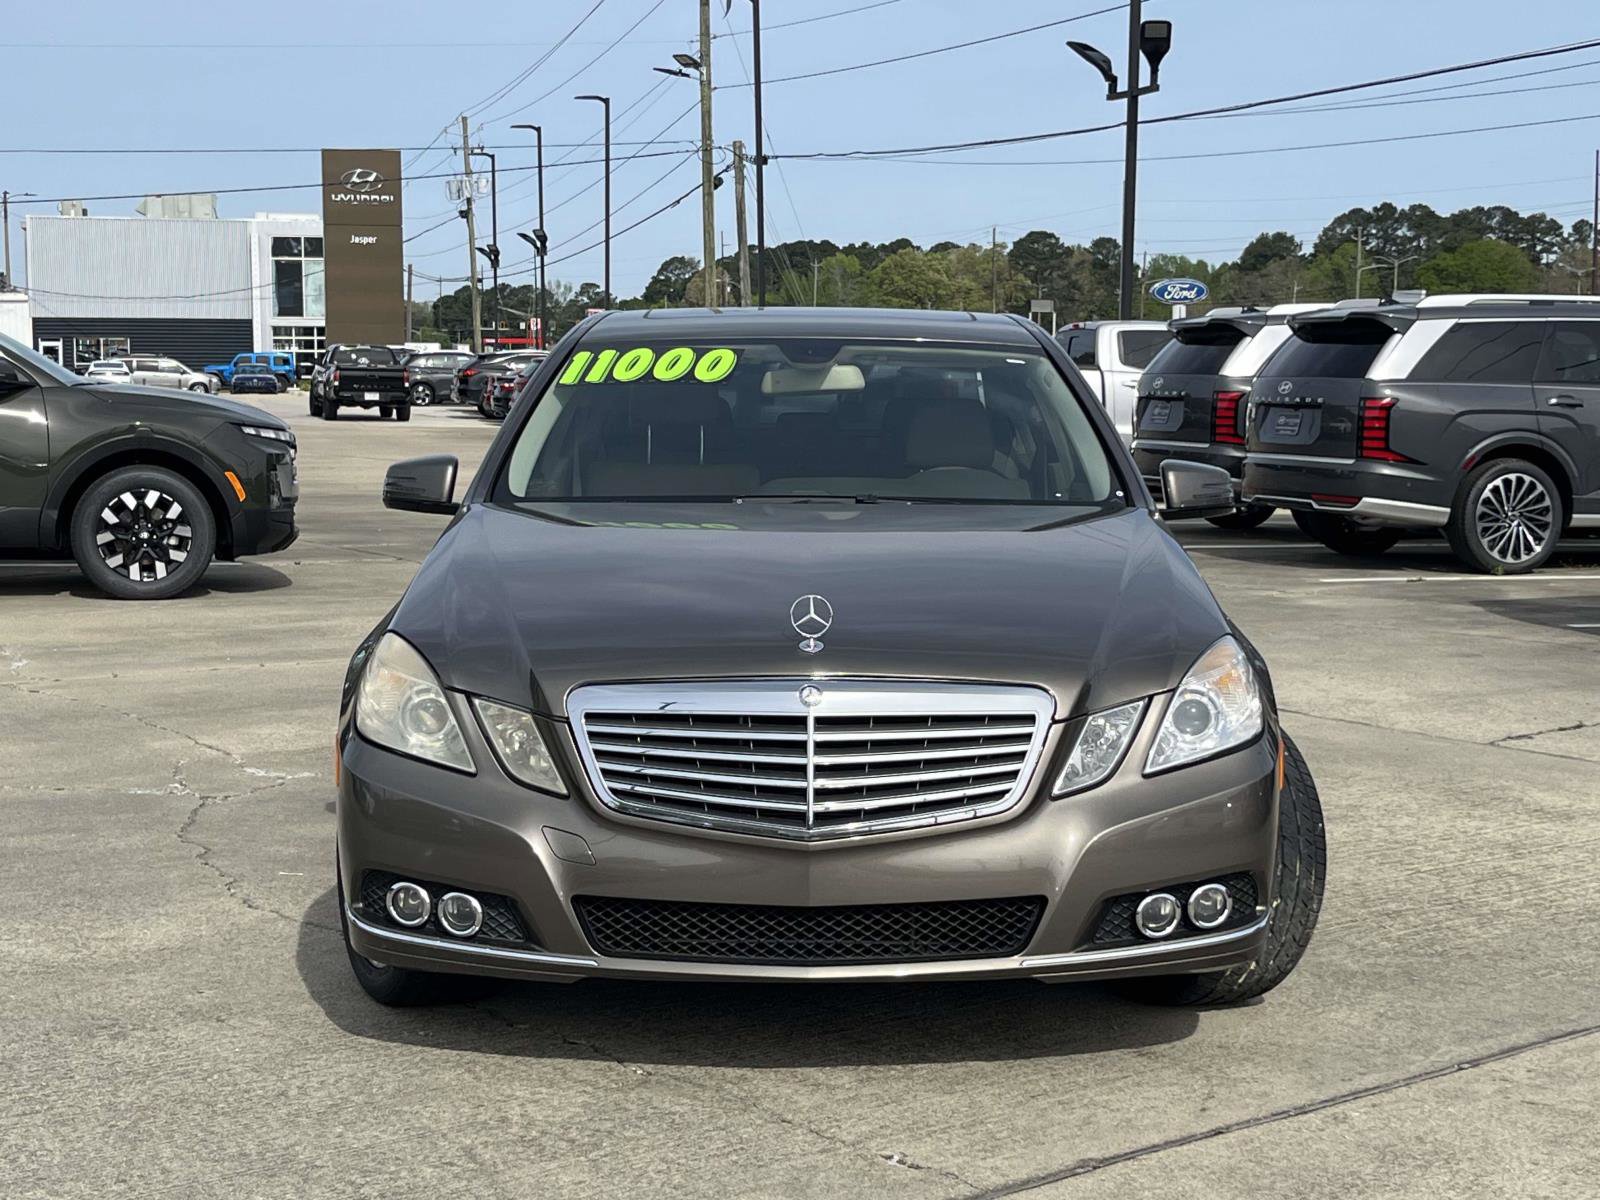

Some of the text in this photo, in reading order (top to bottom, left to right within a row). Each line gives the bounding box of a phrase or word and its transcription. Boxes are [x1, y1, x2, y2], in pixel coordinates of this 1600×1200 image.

[350, 235, 377, 245] Jasper
[1164, 284, 1198, 299] Ford
[558, 347, 738, 385] 11000
